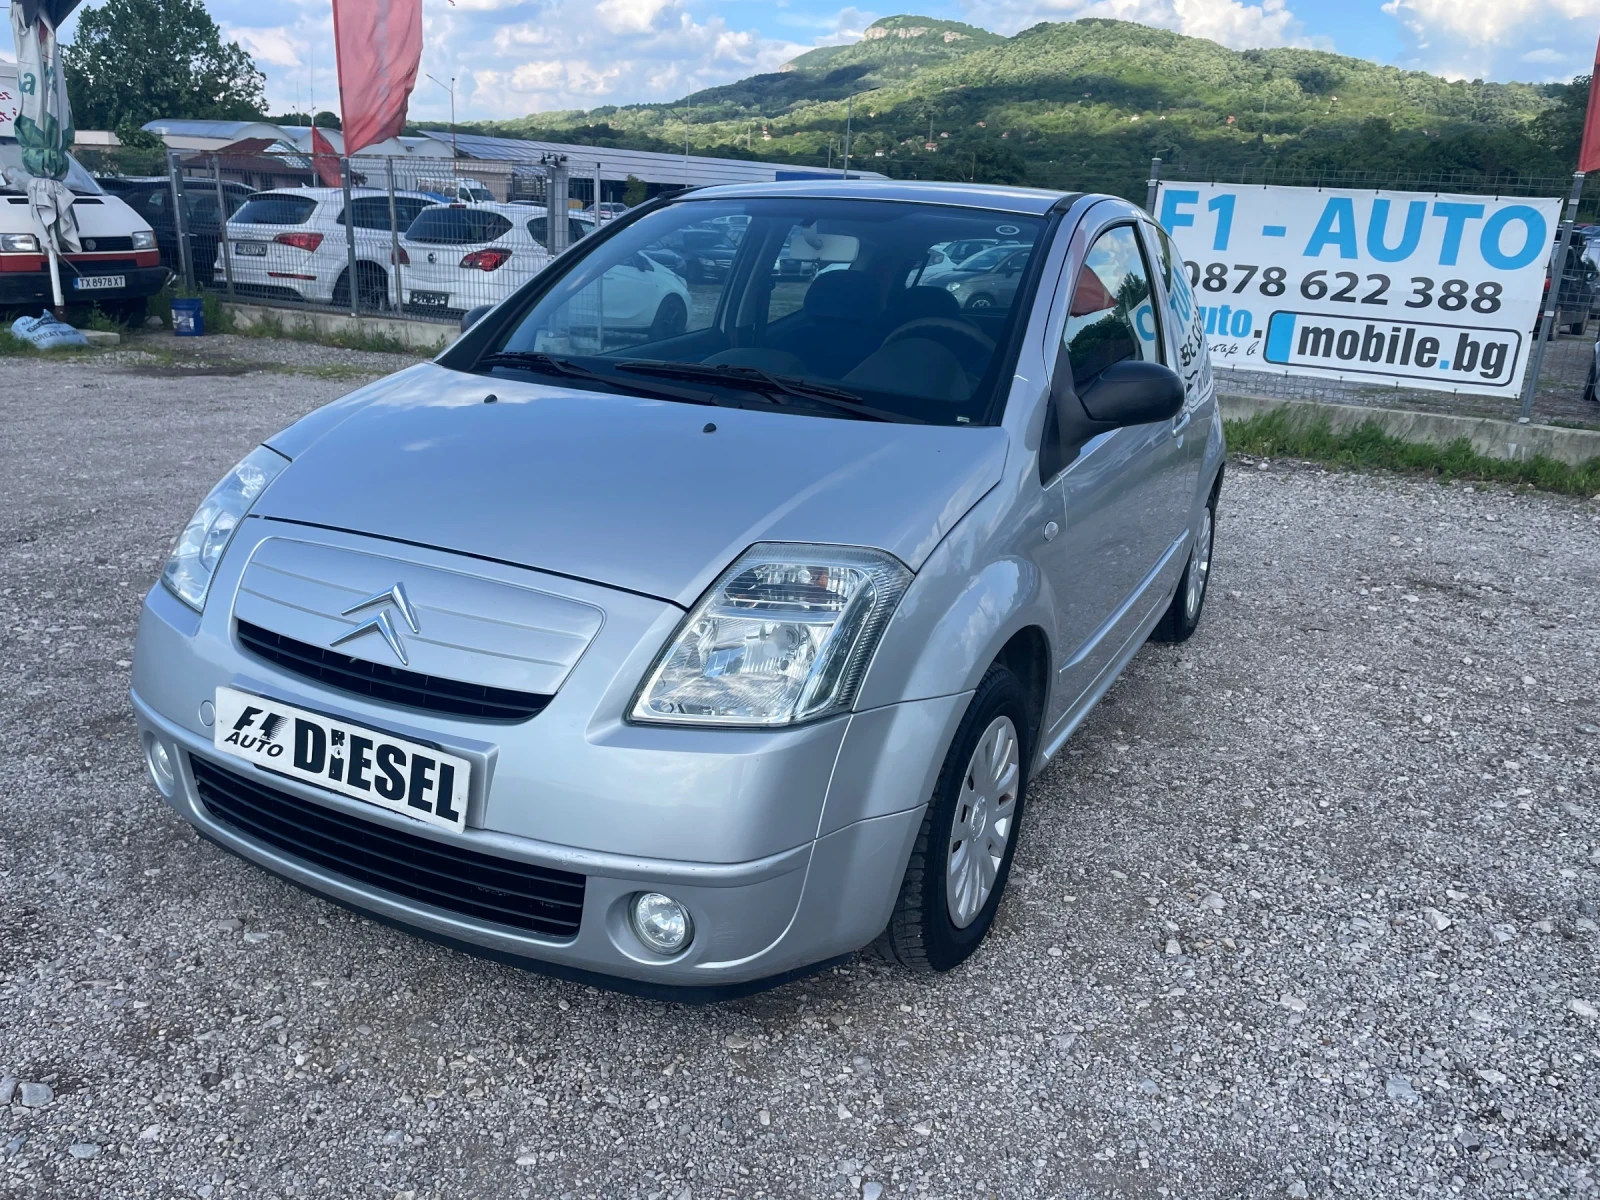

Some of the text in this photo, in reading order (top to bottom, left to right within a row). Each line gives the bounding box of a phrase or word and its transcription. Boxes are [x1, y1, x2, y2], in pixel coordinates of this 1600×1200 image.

[1161, 190, 1236, 251] F1
[1303, 197, 1547, 270] AUTO
[1300, 270, 1390, 306] 622
[1405, 277, 1502, 314] 388
[1297, 325, 1509, 379] mobile.bg
[224, 731, 284, 758] AUTO
